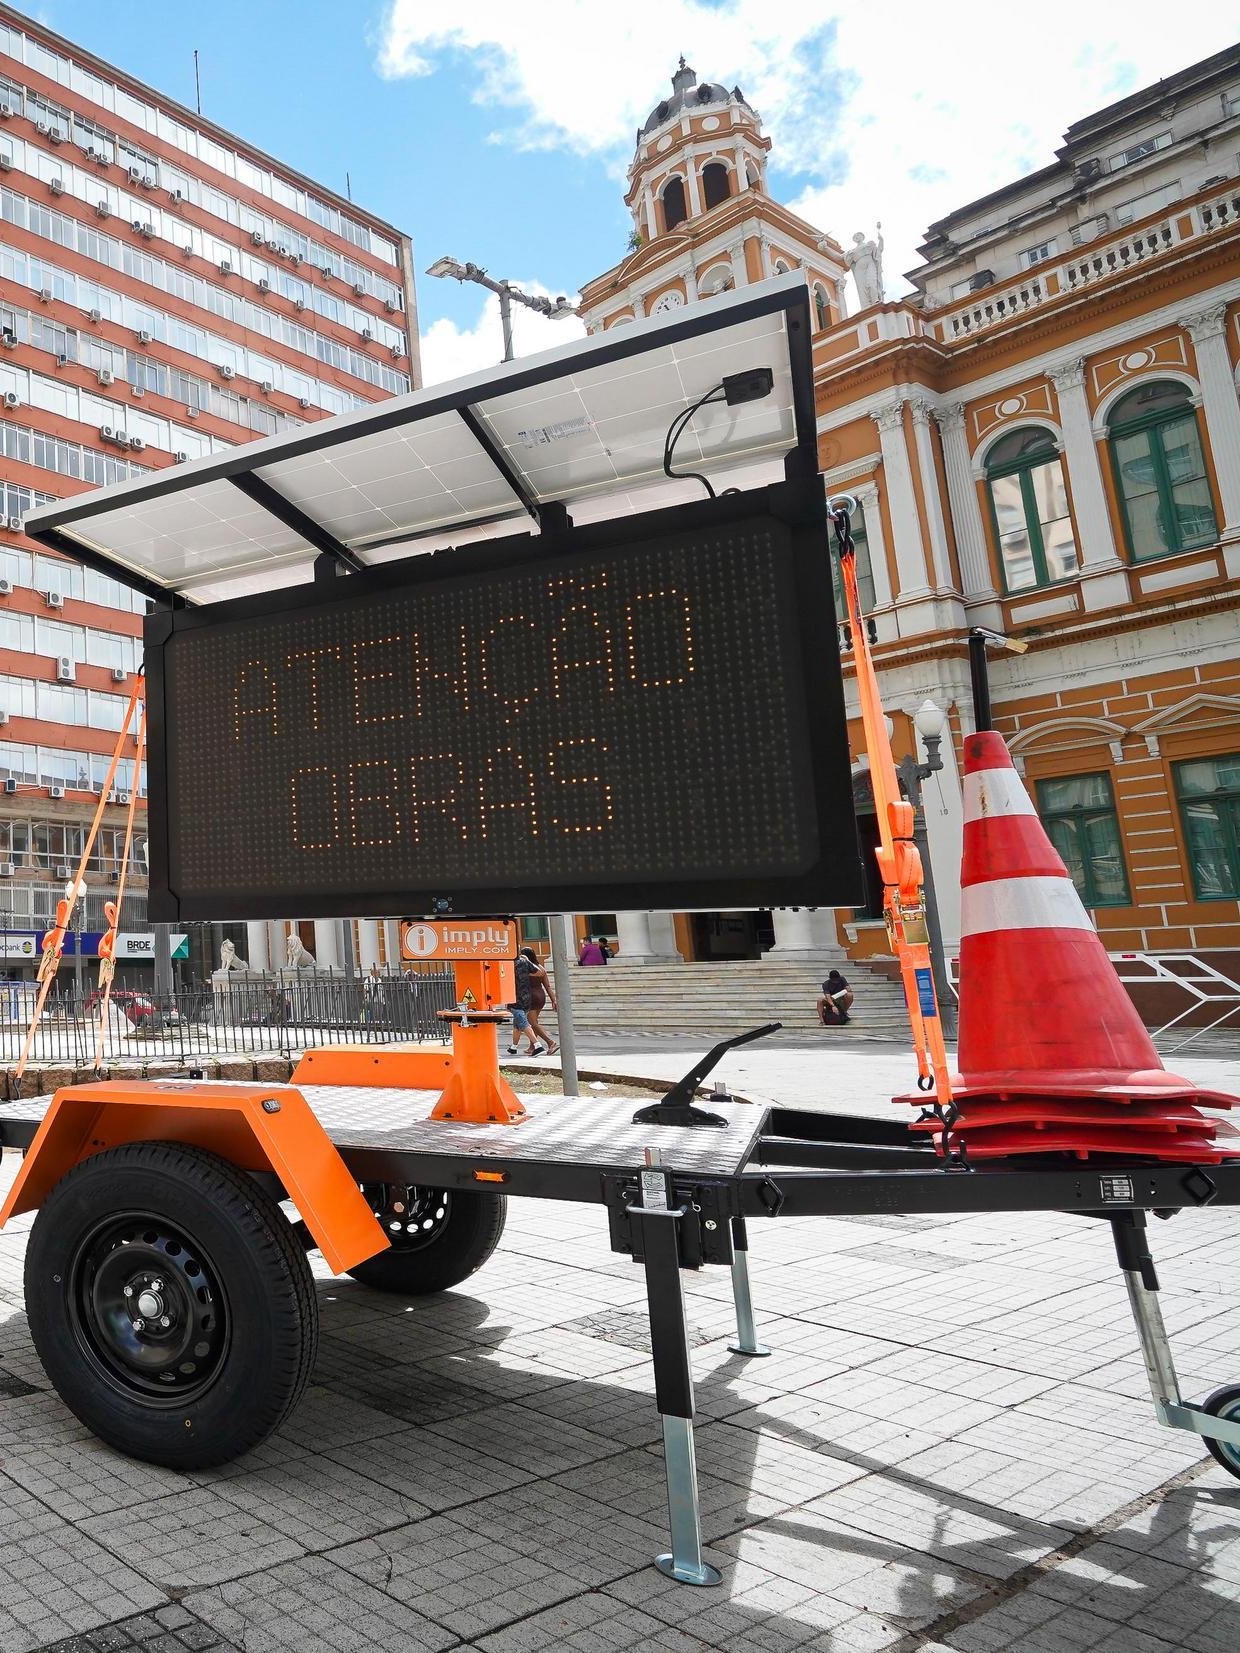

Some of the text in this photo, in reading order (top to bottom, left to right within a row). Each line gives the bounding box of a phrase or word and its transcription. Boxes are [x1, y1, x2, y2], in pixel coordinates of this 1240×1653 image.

[234, 571, 694, 740] ATENÇÃO
[290, 738, 613, 849] OBRAS
[127, 940, 151, 949] BRDE
[442, 926, 509, 946] imply
